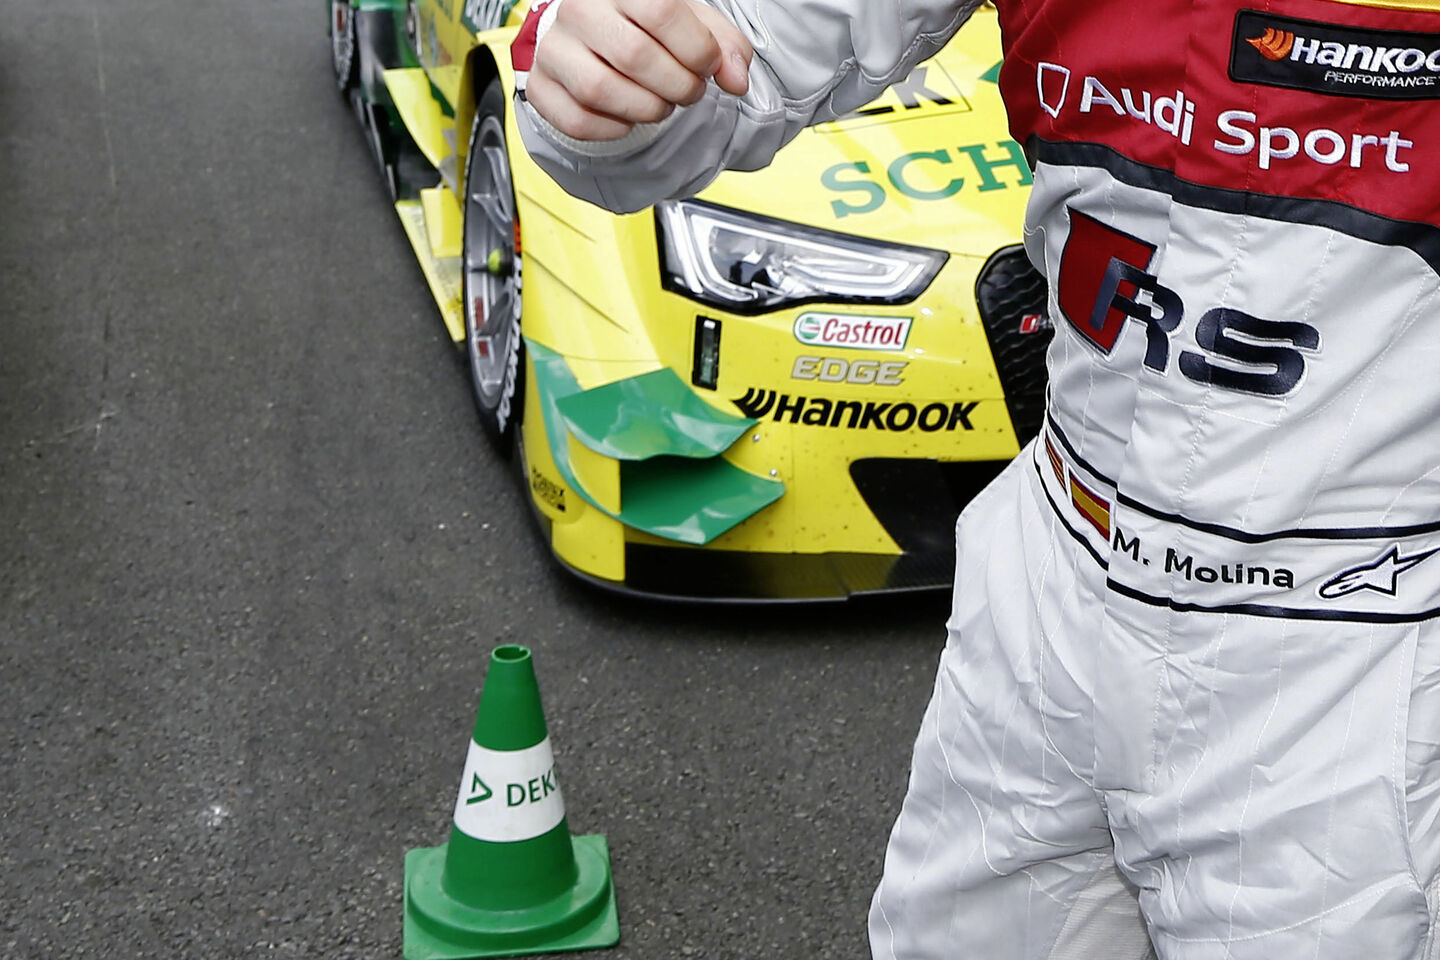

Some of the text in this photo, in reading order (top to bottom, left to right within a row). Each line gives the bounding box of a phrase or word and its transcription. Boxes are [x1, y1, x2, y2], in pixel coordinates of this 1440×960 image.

[1323, 69, 1434, 88] PERFORMANCE
[1079, 75, 1414, 173] Audi Sport
[821, 317, 904, 347] Castrol
[1089, 255, 1320, 396] RS
[790, 355, 910, 387] EDGE
[1112, 526, 1296, 590] M. Molina
